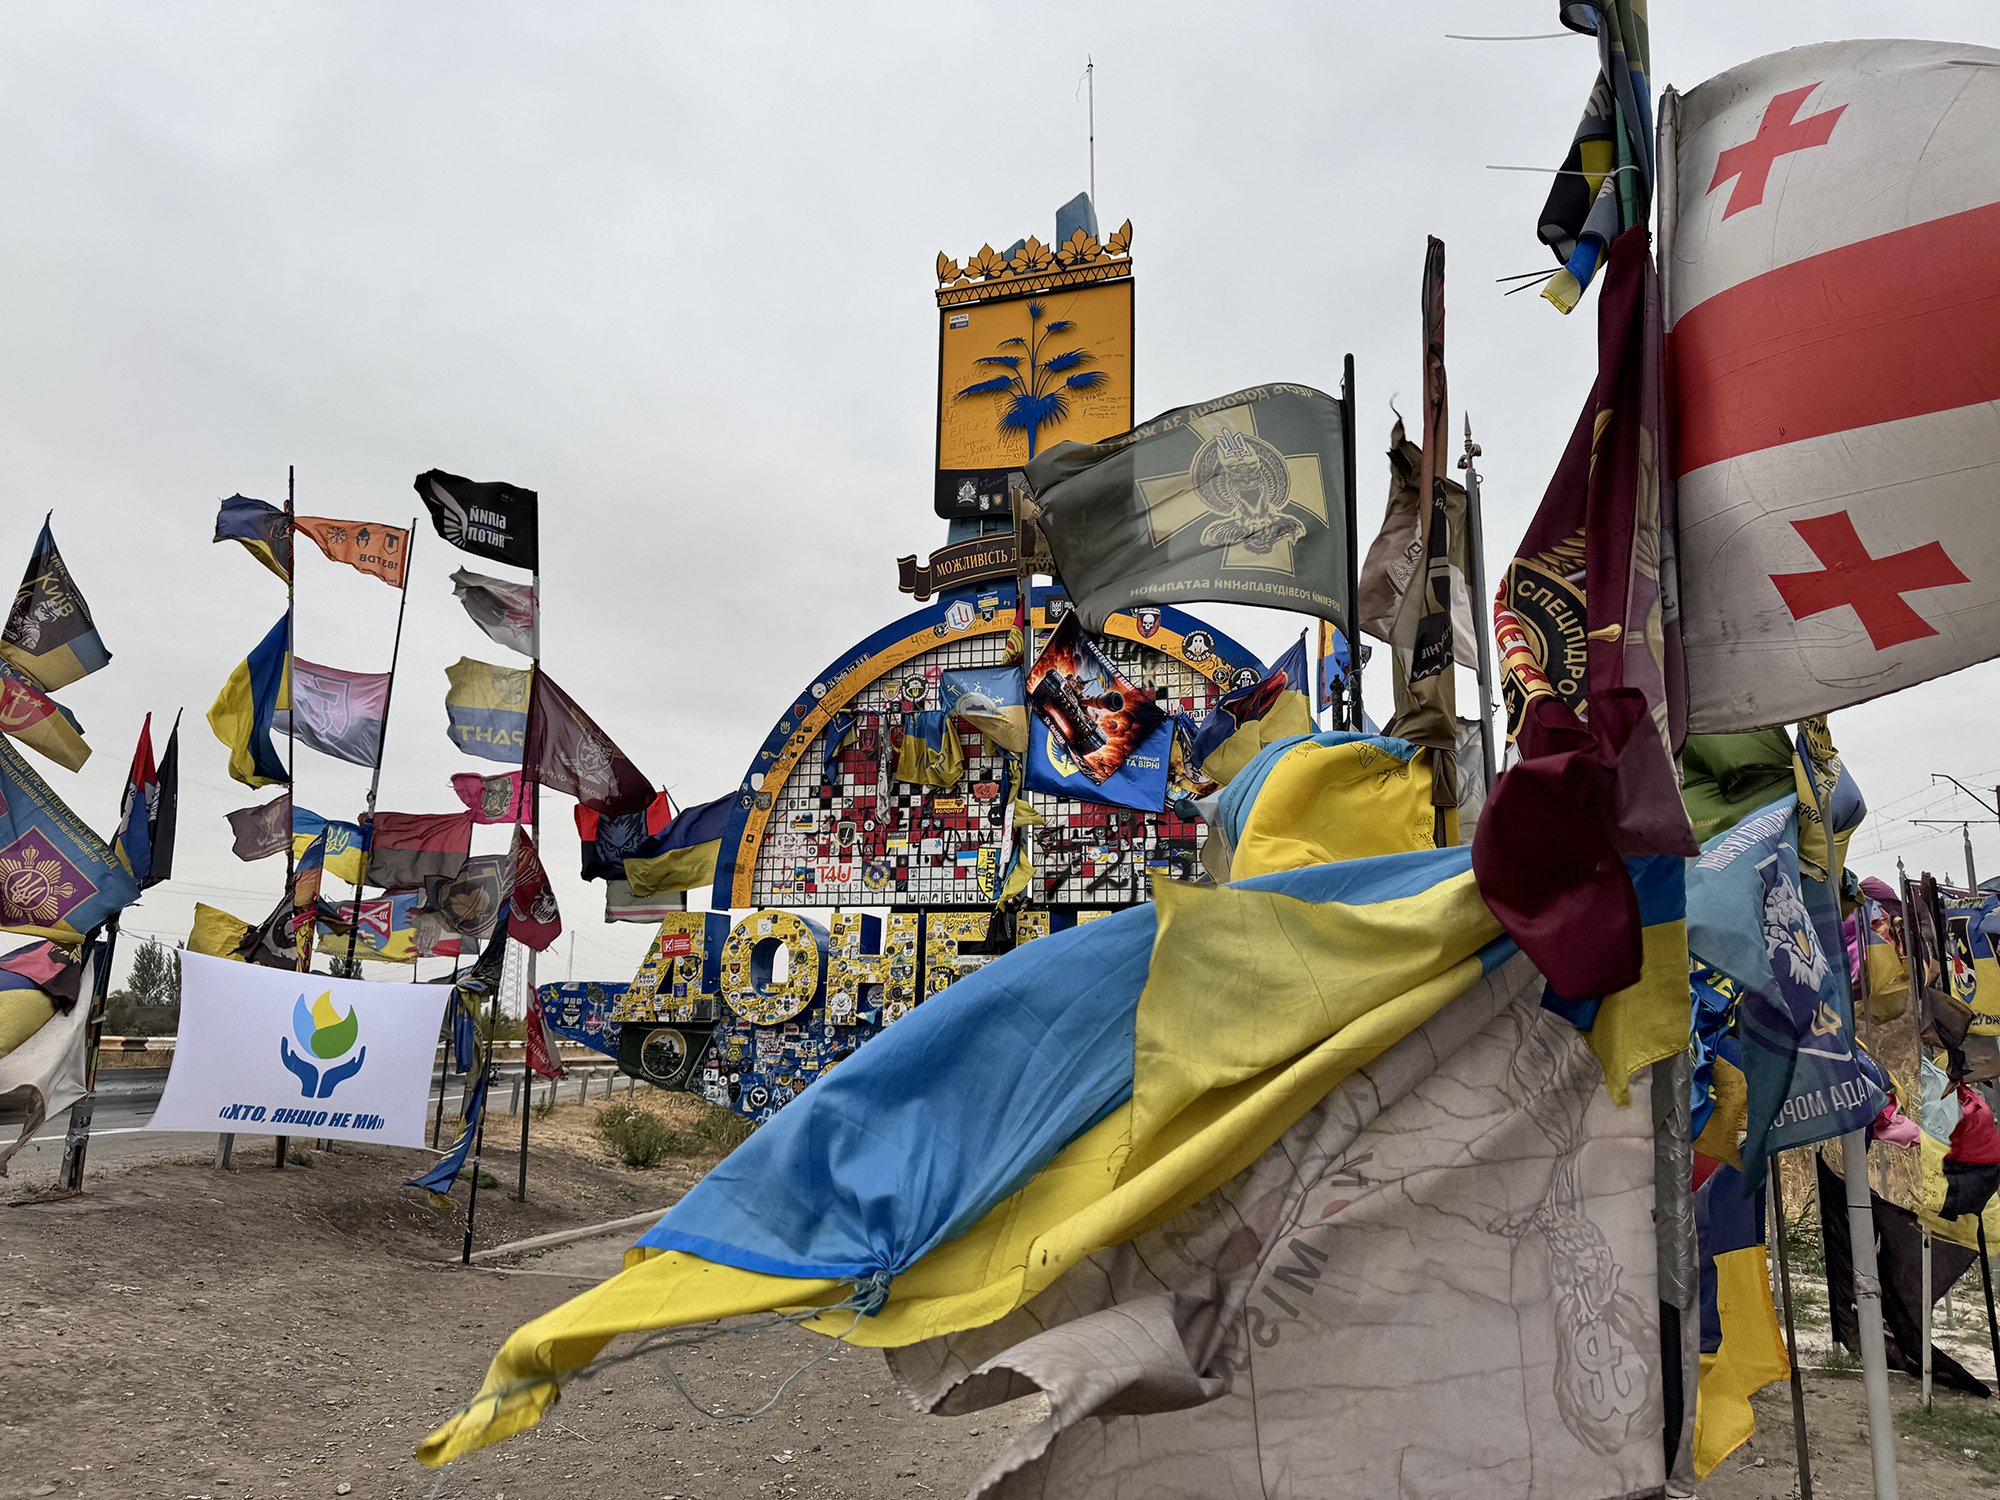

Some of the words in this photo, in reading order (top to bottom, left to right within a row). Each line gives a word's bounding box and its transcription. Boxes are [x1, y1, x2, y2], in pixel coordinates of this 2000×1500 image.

[936, 551, 1009, 578] МОЖЛИВІСТЬ
[39, 571, 75, 618] КИЇВ
[1138, 760, 1160, 770] ВІРНІ
[25, 765, 88, 837] ПРЕЗИДЕНТСЬКА
[984, 850, 996, 893] VIRTUS
[218, 1103, 268, 1124] «ХТО,
[270, 1107, 329, 1128] ЯКЩО
[328, 1112, 353, 1128] НЕ
[351, 1113, 386, 1131] МИ»
